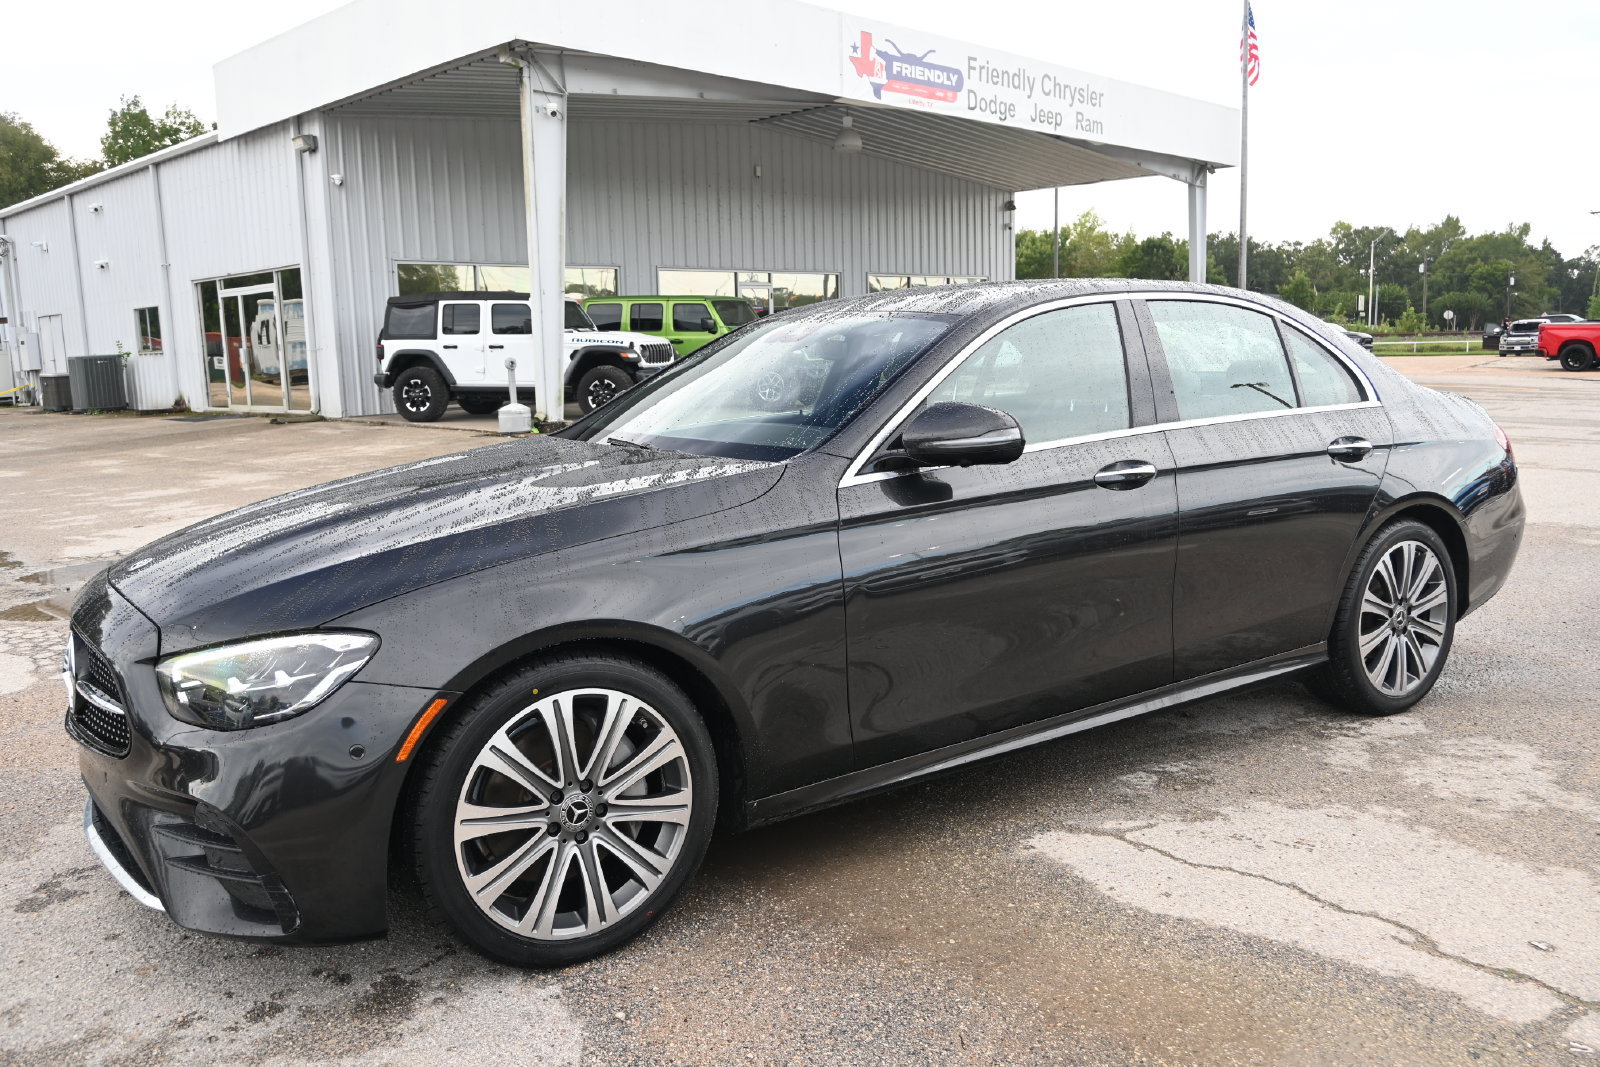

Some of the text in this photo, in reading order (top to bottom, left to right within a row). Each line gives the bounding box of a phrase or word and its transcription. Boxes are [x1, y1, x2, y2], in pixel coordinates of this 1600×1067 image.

[892, 61, 959, 86] FRIENDLY
[967, 56, 1104, 108] Friendly Chrysler
[967, 89, 1104, 135] Dodge Jeep Ram
